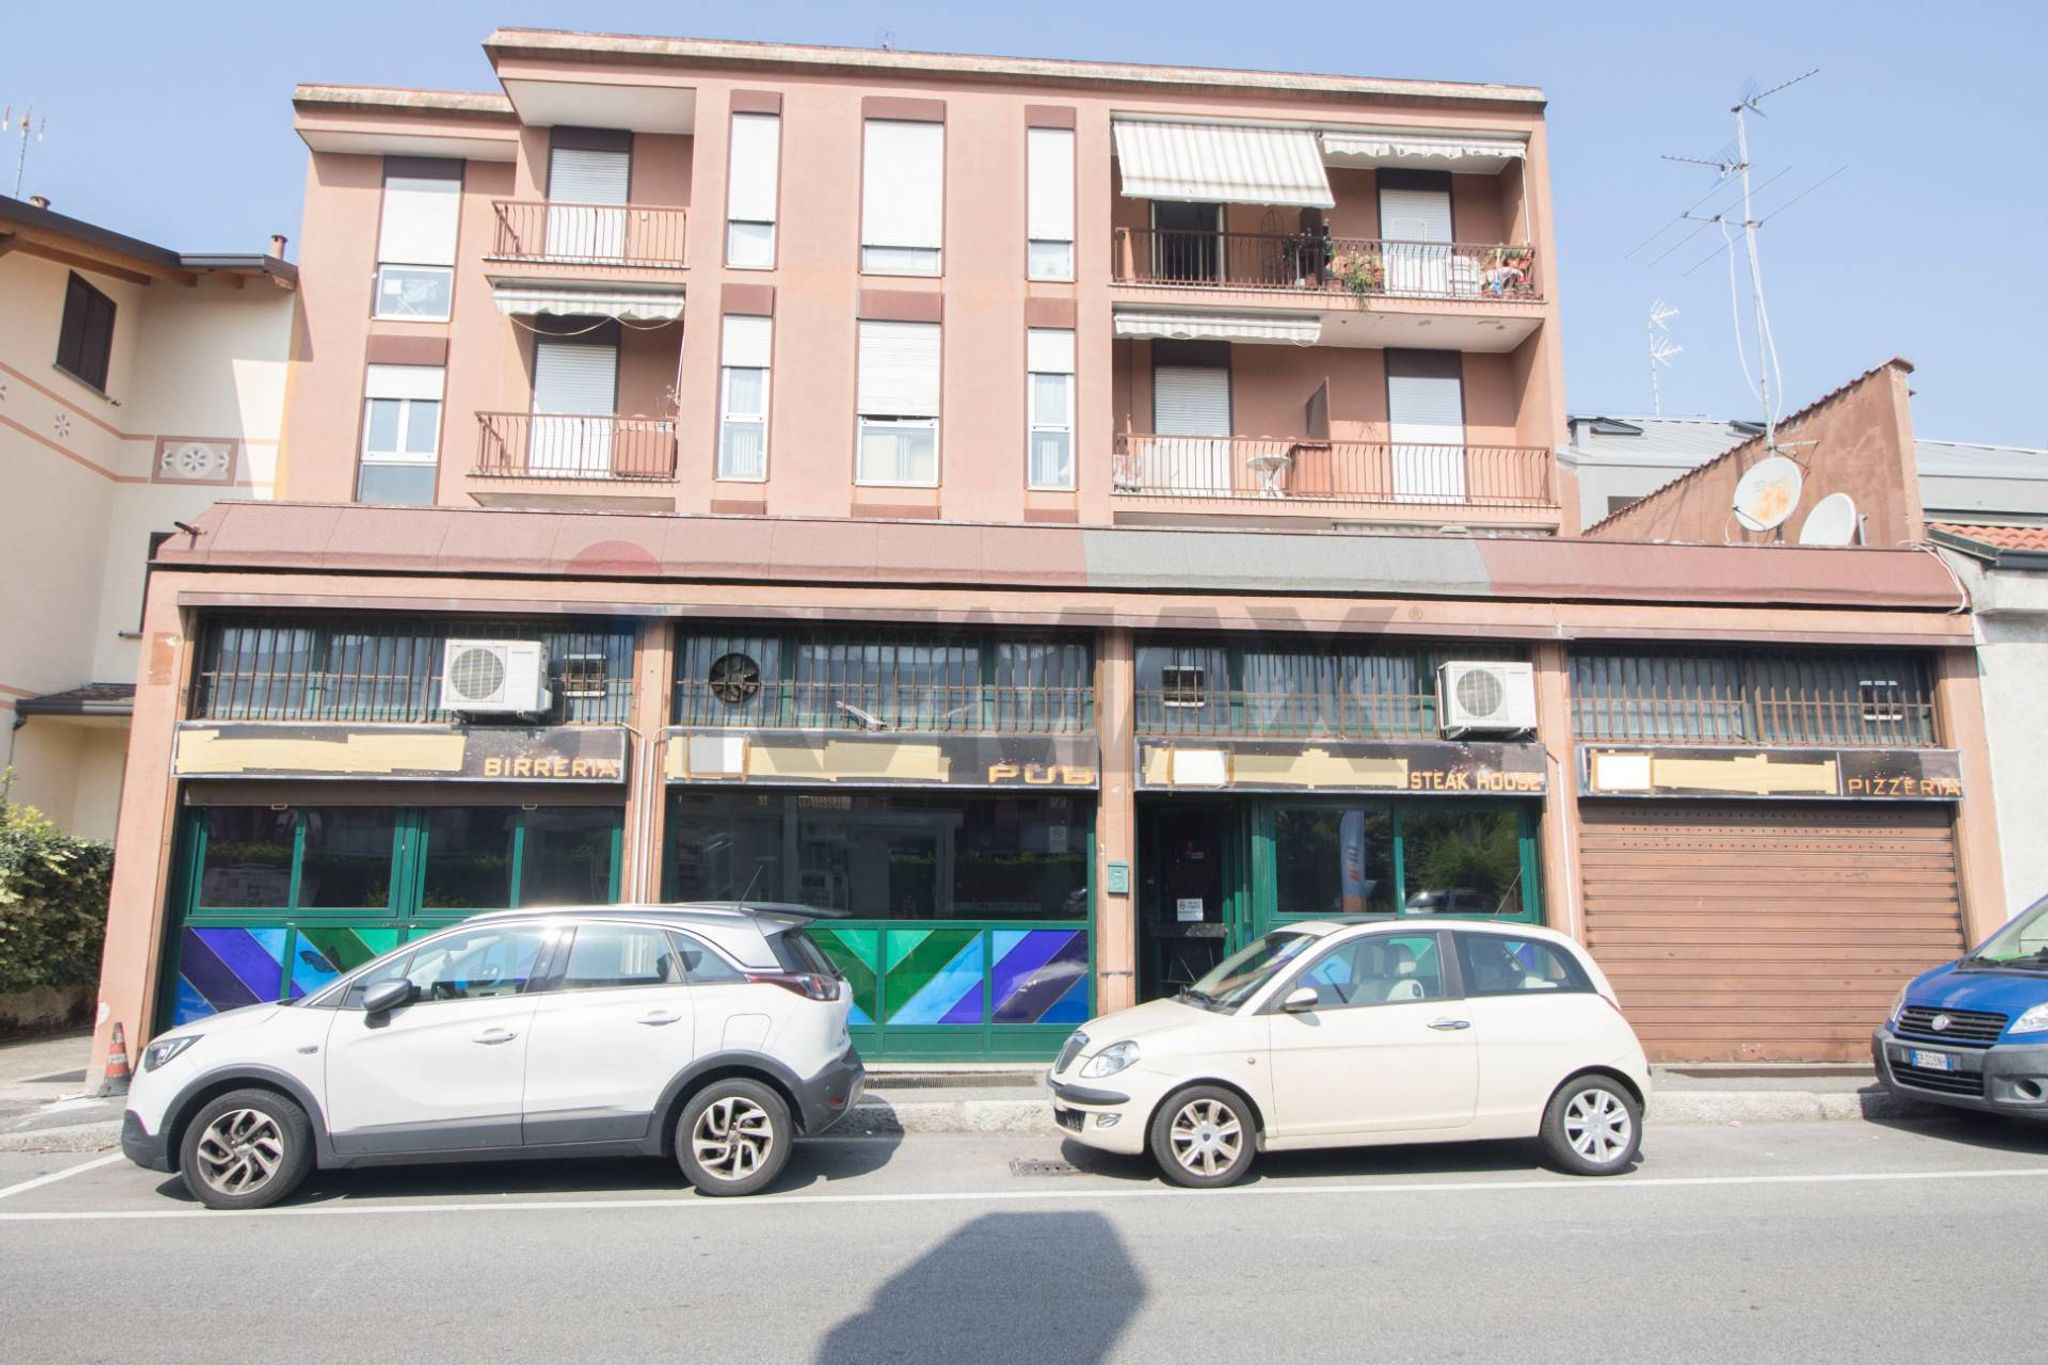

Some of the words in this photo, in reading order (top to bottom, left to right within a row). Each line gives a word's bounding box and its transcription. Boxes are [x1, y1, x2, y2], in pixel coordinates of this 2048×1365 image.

[484, 757, 619, 777] BIRRERIA
[988, 764, 1095, 784] PUB
[1410, 771, 1470, 790] STEAK
[1476, 771, 1541, 791] HOUSE
[1847, 778, 1961, 796] PIZZERIA
